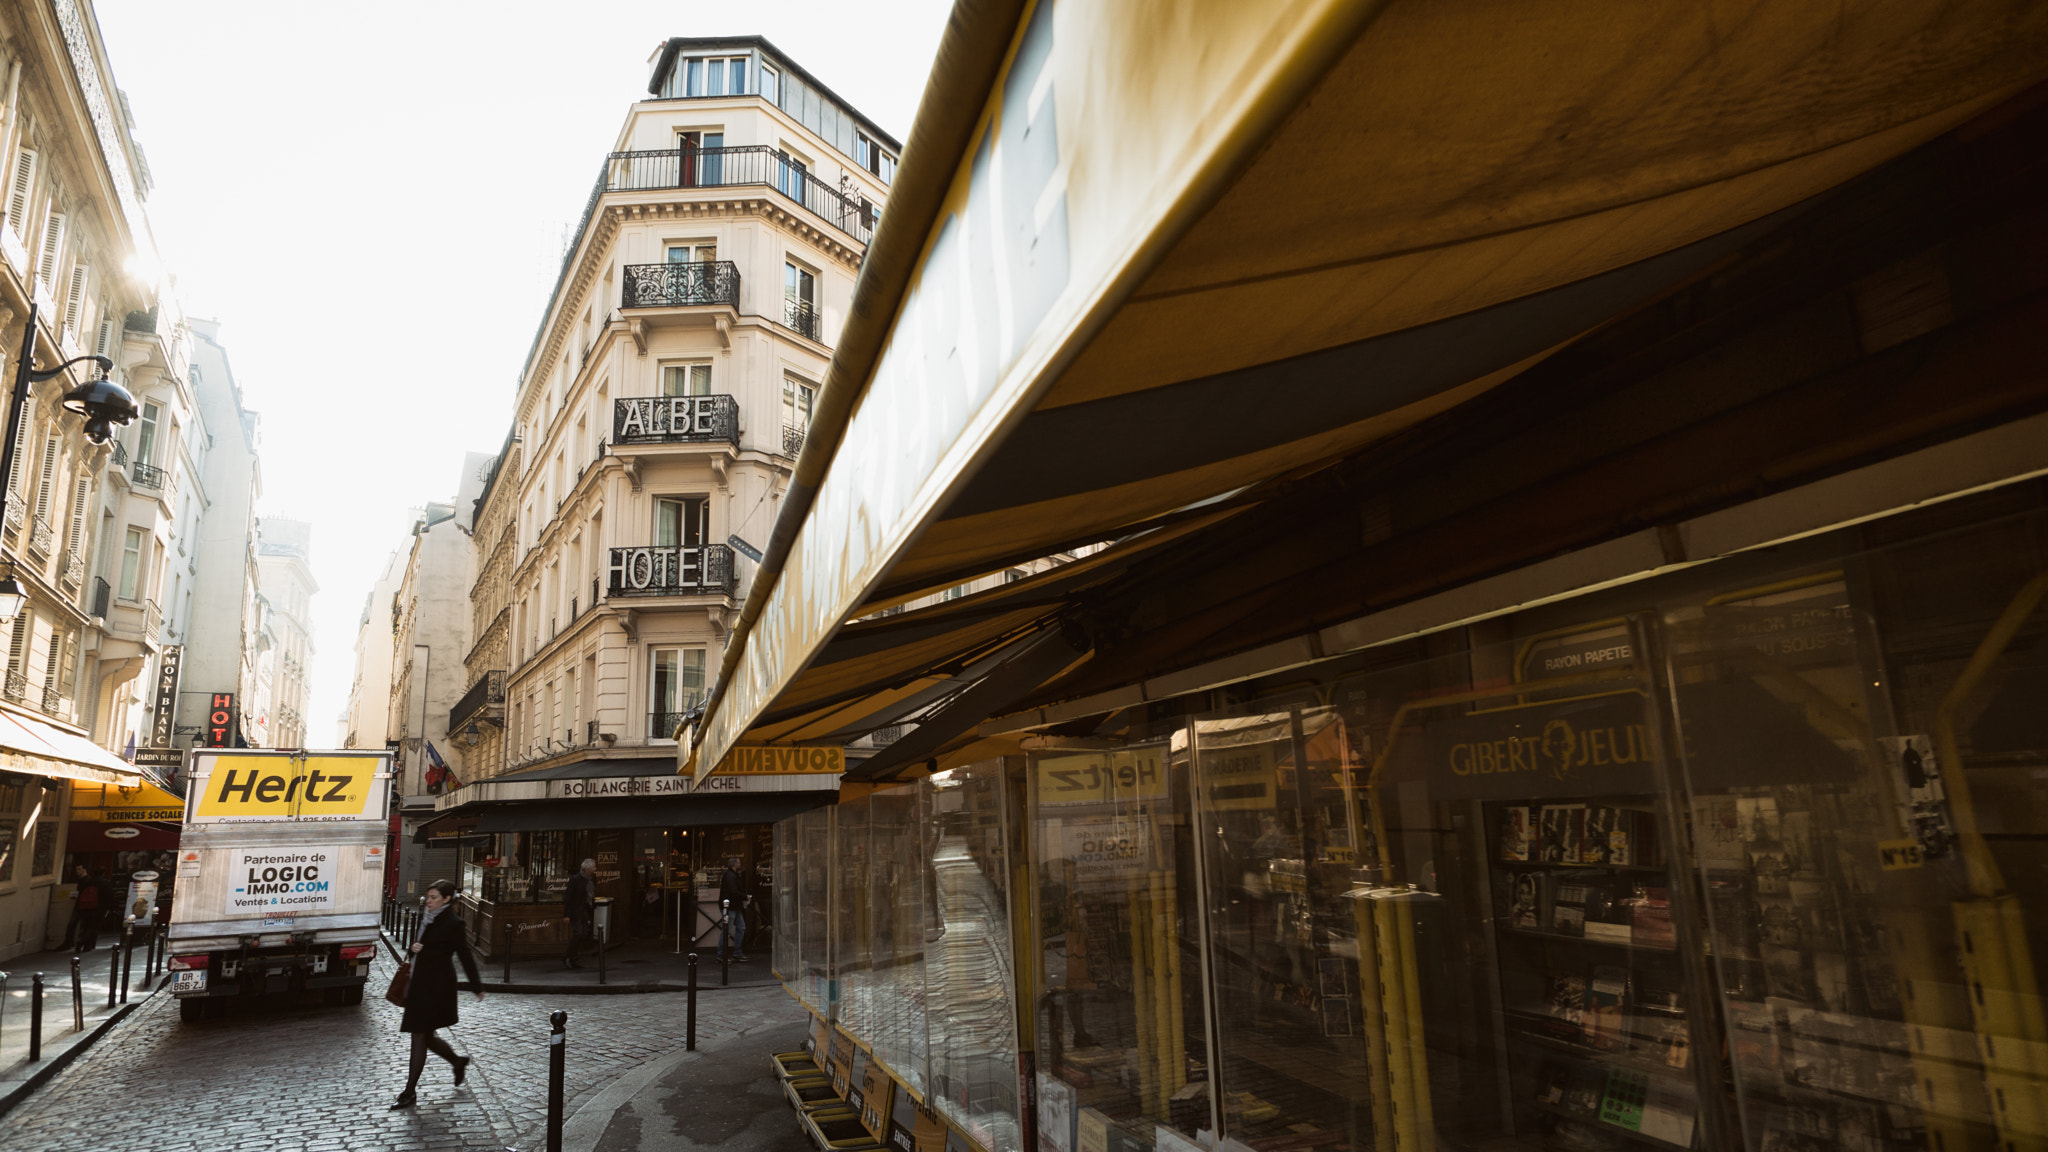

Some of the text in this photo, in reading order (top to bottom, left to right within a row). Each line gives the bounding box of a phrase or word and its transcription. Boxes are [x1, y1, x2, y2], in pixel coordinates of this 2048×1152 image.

[620, 397, 714, 436] ALBE
[606, 547, 723, 589] HOTEL
[1544, 645, 1633, 671] RAYON PAPETE
[156, 656, 177, 745] MONT BLANC
[211, 694, 231, 748] HOT
[136, 753, 182, 762] JARDIN DU ROI
[1450, 736, 1542, 776] GIBERT
[217, 769, 353, 804] Hertz
[564, 779, 650, 795] BOULANGERIE
[655, 778, 692, 792] SAINT
[106, 810, 185, 820] SCIENCES SOCIALE
[243, 853, 326, 865] Partenaire de
[597, 853, 618, 862] PAIN
[248, 865, 319, 884] LOGIC
[234, 895, 328, 907] Ventes & Locations
